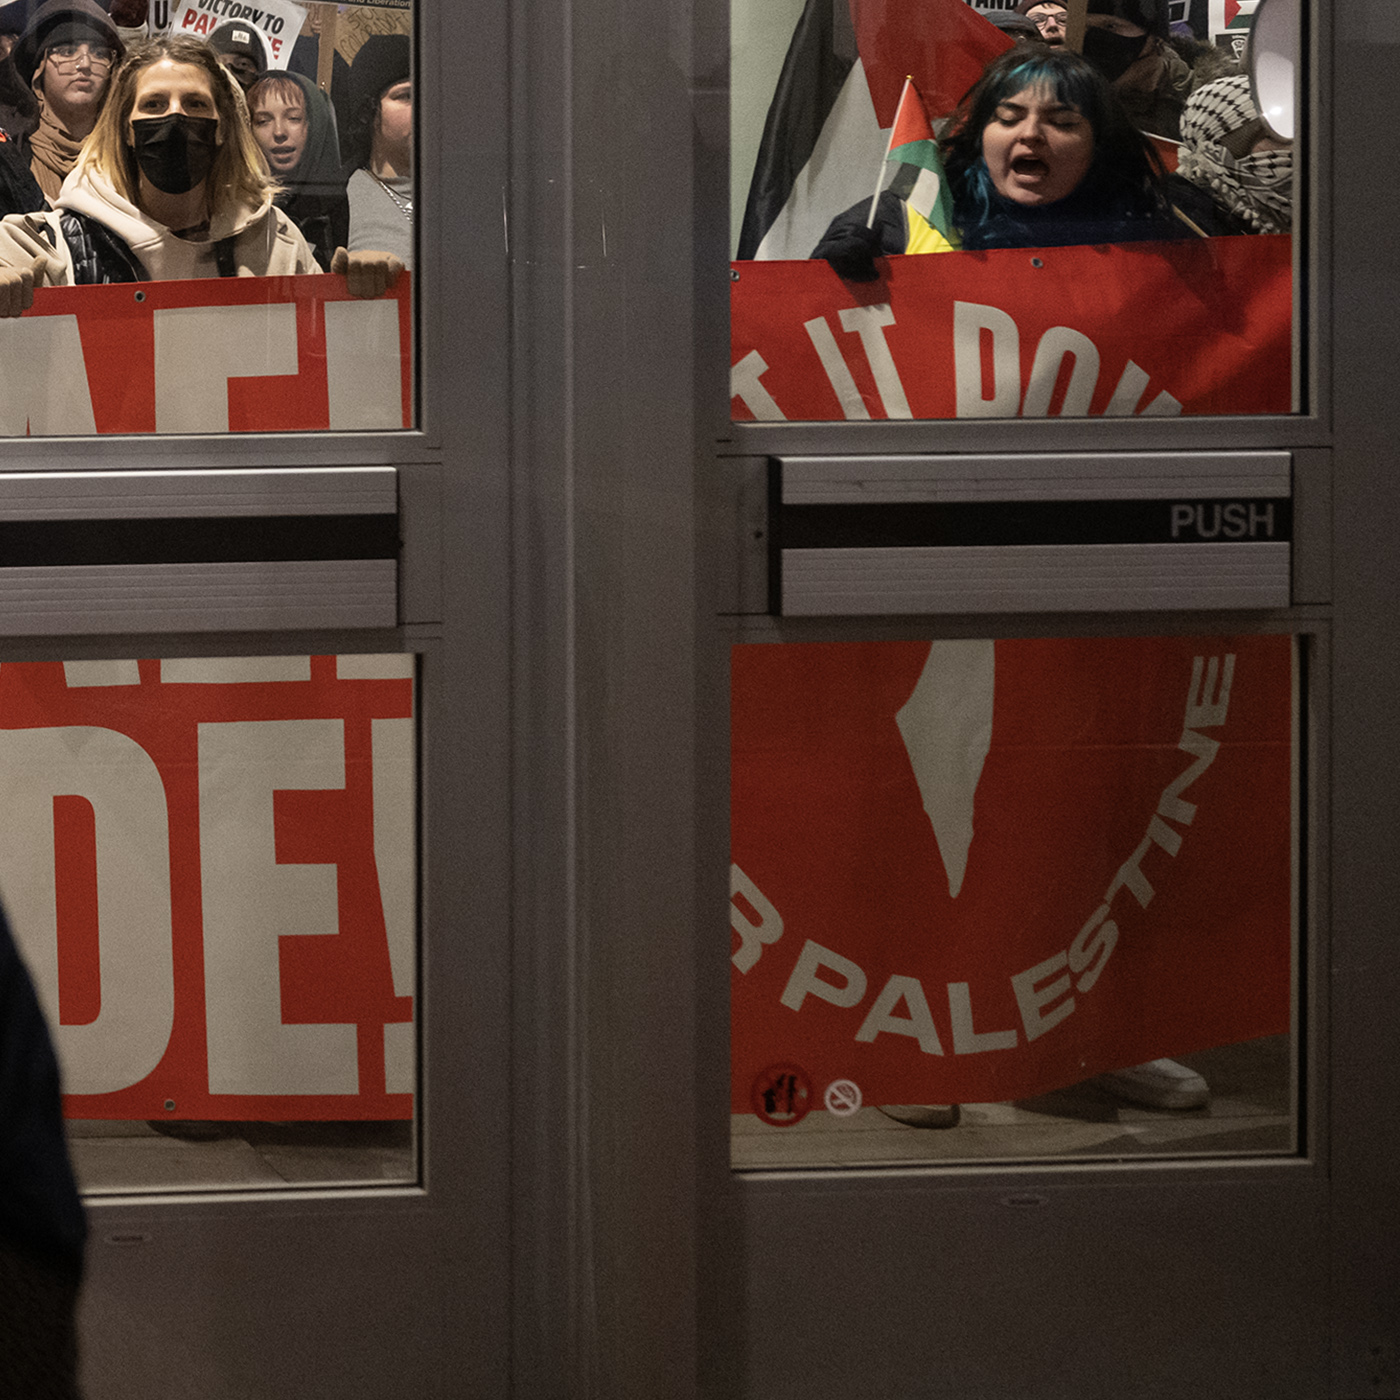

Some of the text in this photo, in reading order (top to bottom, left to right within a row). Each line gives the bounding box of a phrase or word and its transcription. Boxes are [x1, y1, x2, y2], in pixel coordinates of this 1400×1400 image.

[261, 13, 284, 35] TO
[804, 303, 914, 420] IT
[1172, 503, 1274, 538] PUSH
[780, 653, 1236, 1056] PALESTINE
